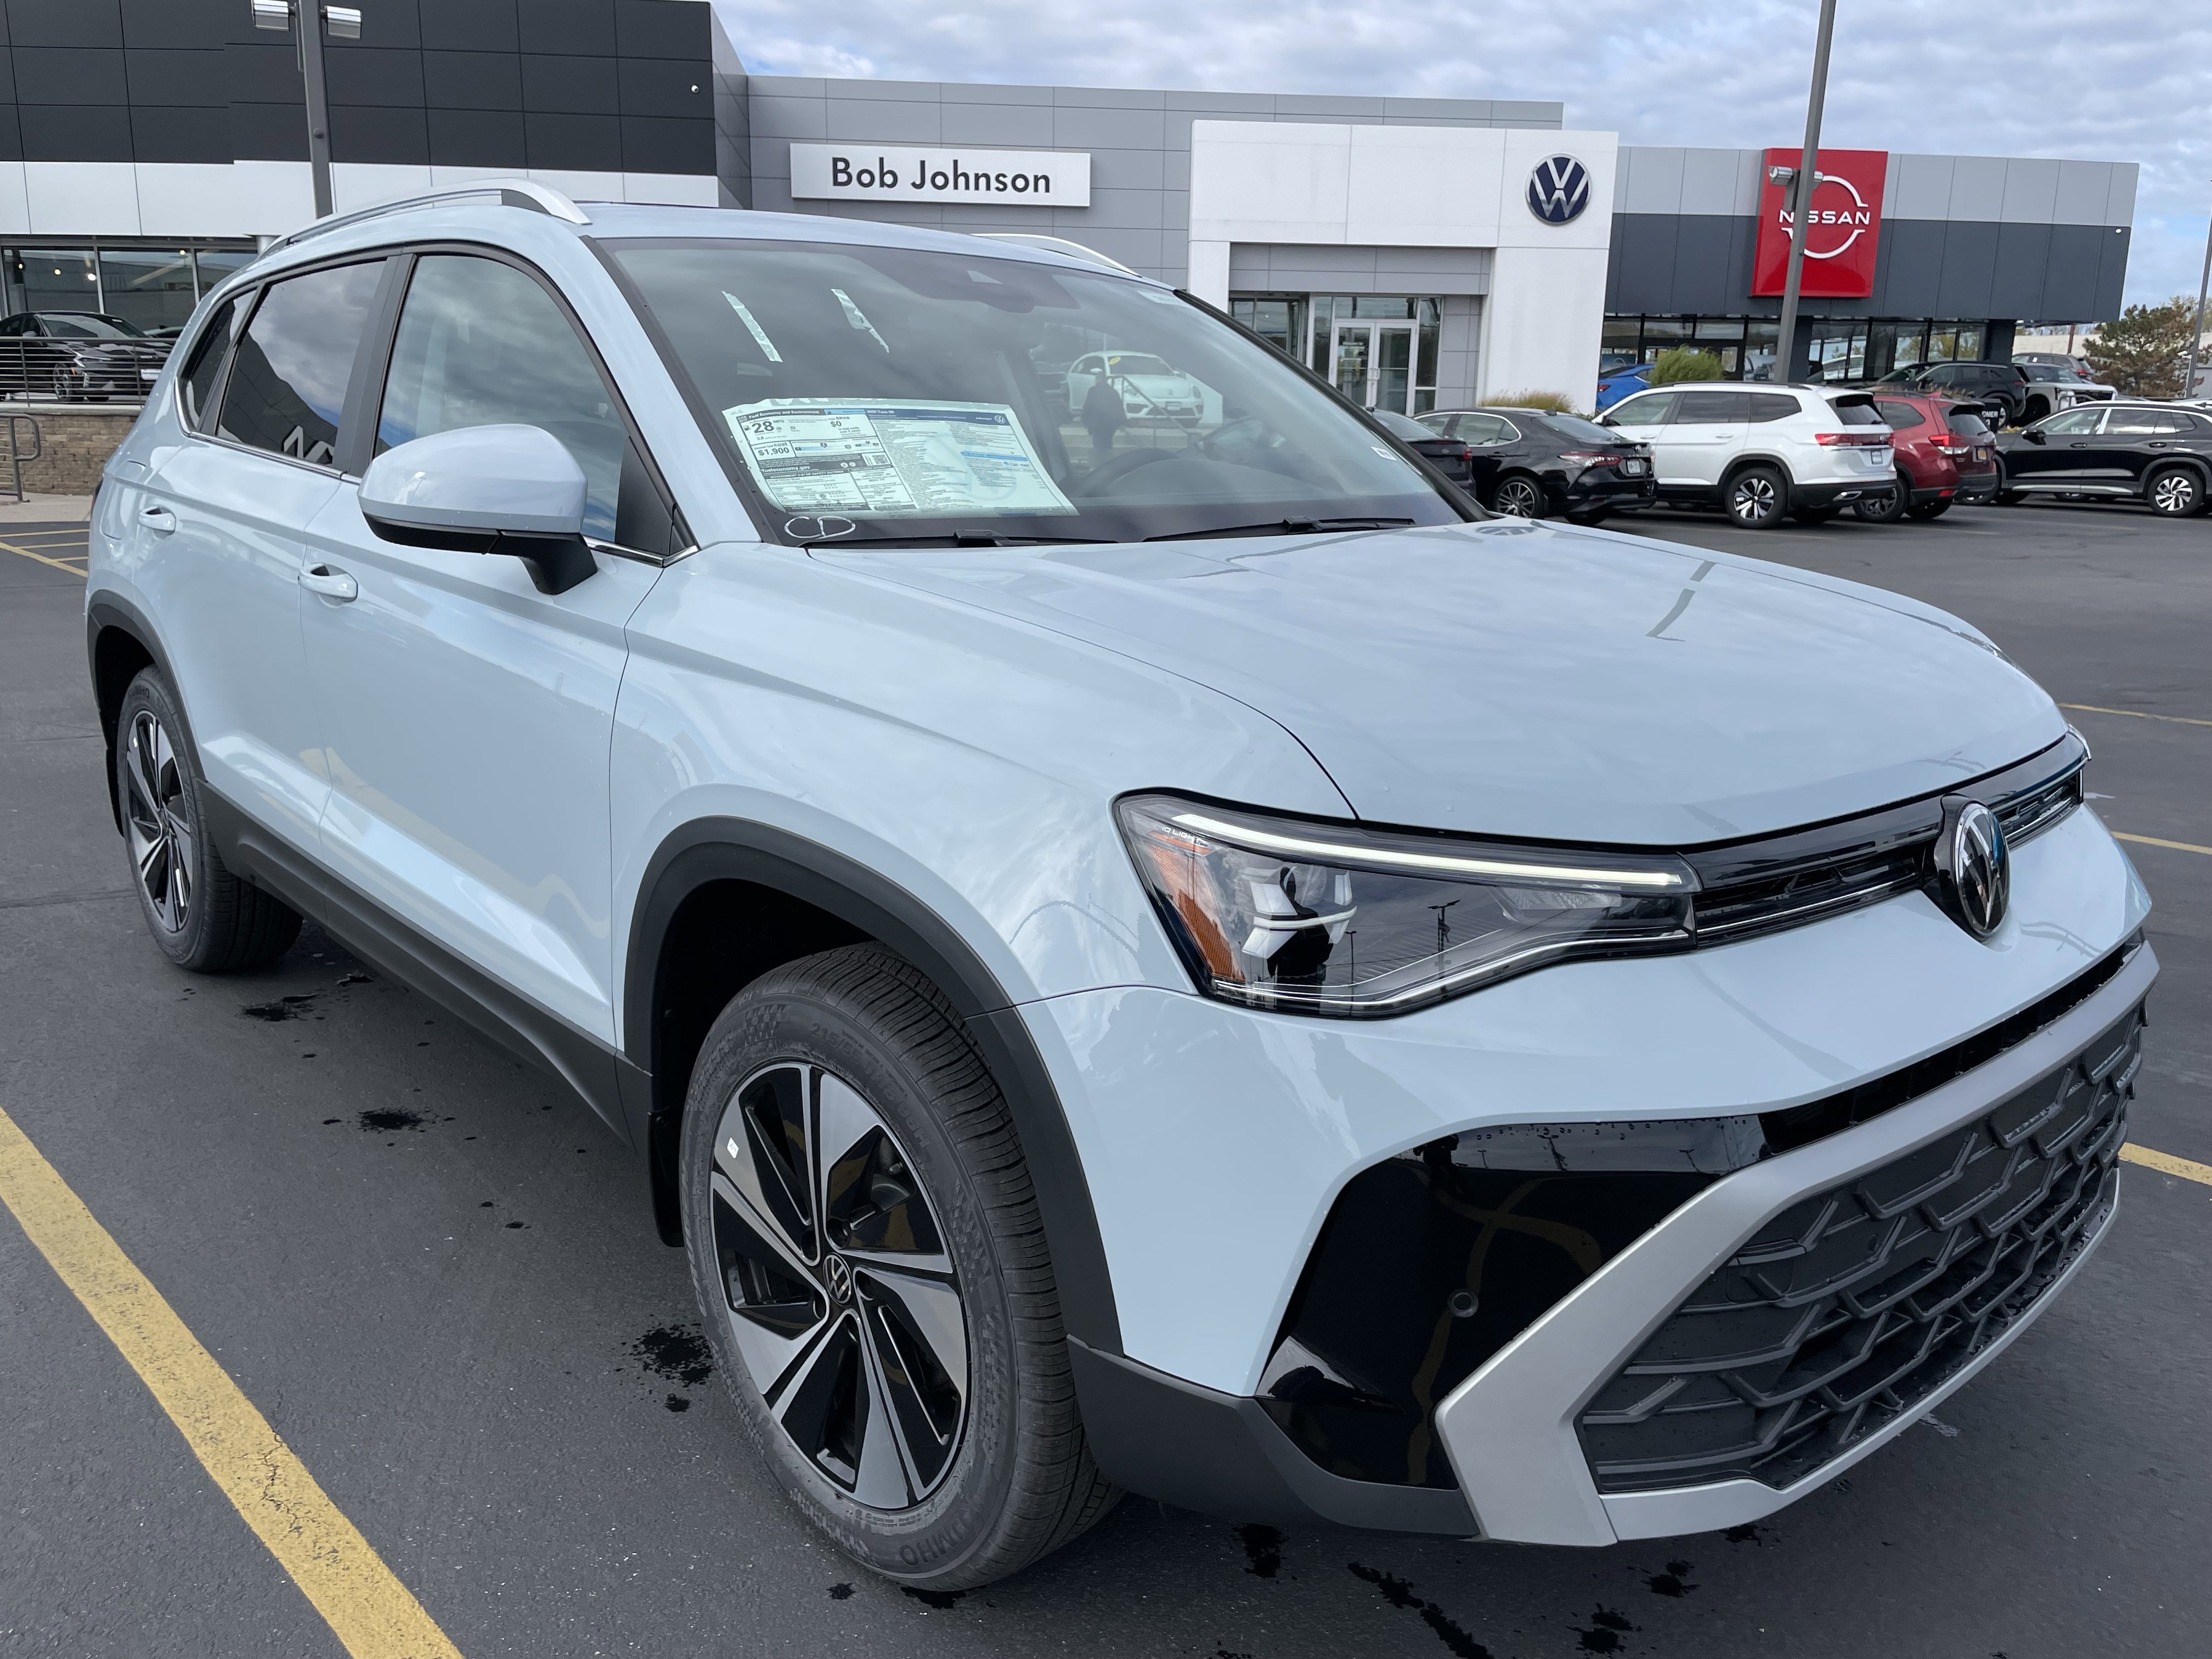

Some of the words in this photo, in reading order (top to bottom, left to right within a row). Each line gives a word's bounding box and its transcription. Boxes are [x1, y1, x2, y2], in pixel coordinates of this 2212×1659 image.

[831, 157, 898, 188] Bob
[910, 159, 1050, 193] Johnson
[1779, 209, 1871, 225] NSSAN
[752, 421, 774, 433] 28
[758, 447, 789, 456] $1,900
